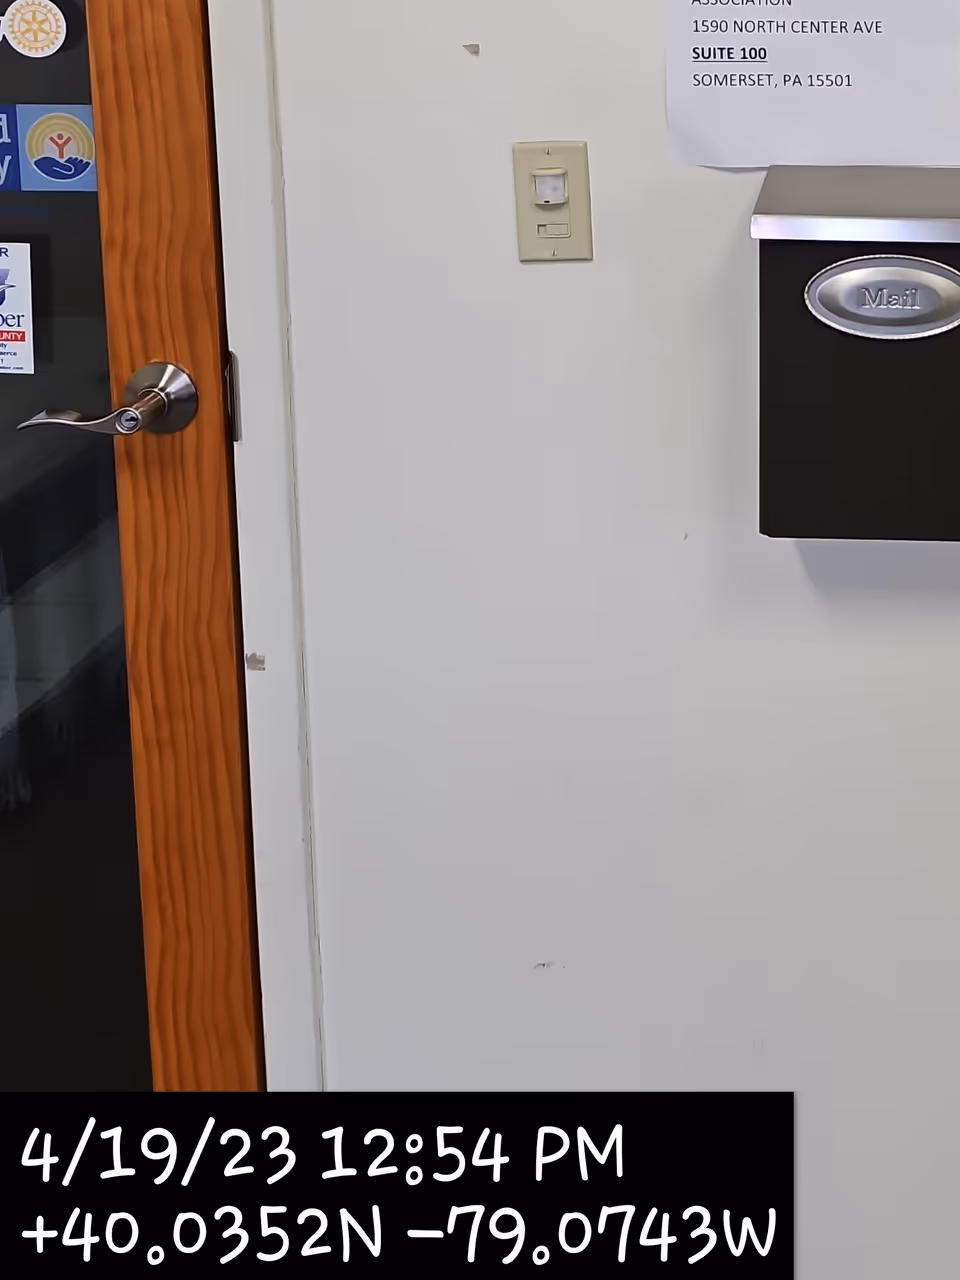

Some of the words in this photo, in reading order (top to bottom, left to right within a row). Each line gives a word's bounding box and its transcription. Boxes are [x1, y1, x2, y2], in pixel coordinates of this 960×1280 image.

[692, 20, 728, 33] 1590
[733, 20, 786, 33] NORTH
[790, 21, 849, 34] CENTER
[852, 21, 883, 34] AVE
[692, 47, 735, 61] SUITE
[740, 47, 767, 61] 100
[692, 74, 778, 89] SOMERSET,
[783, 75, 803, 87] PA
[807, 75, 853, 88] 15501
[861, 288, 920, 310] Mail
